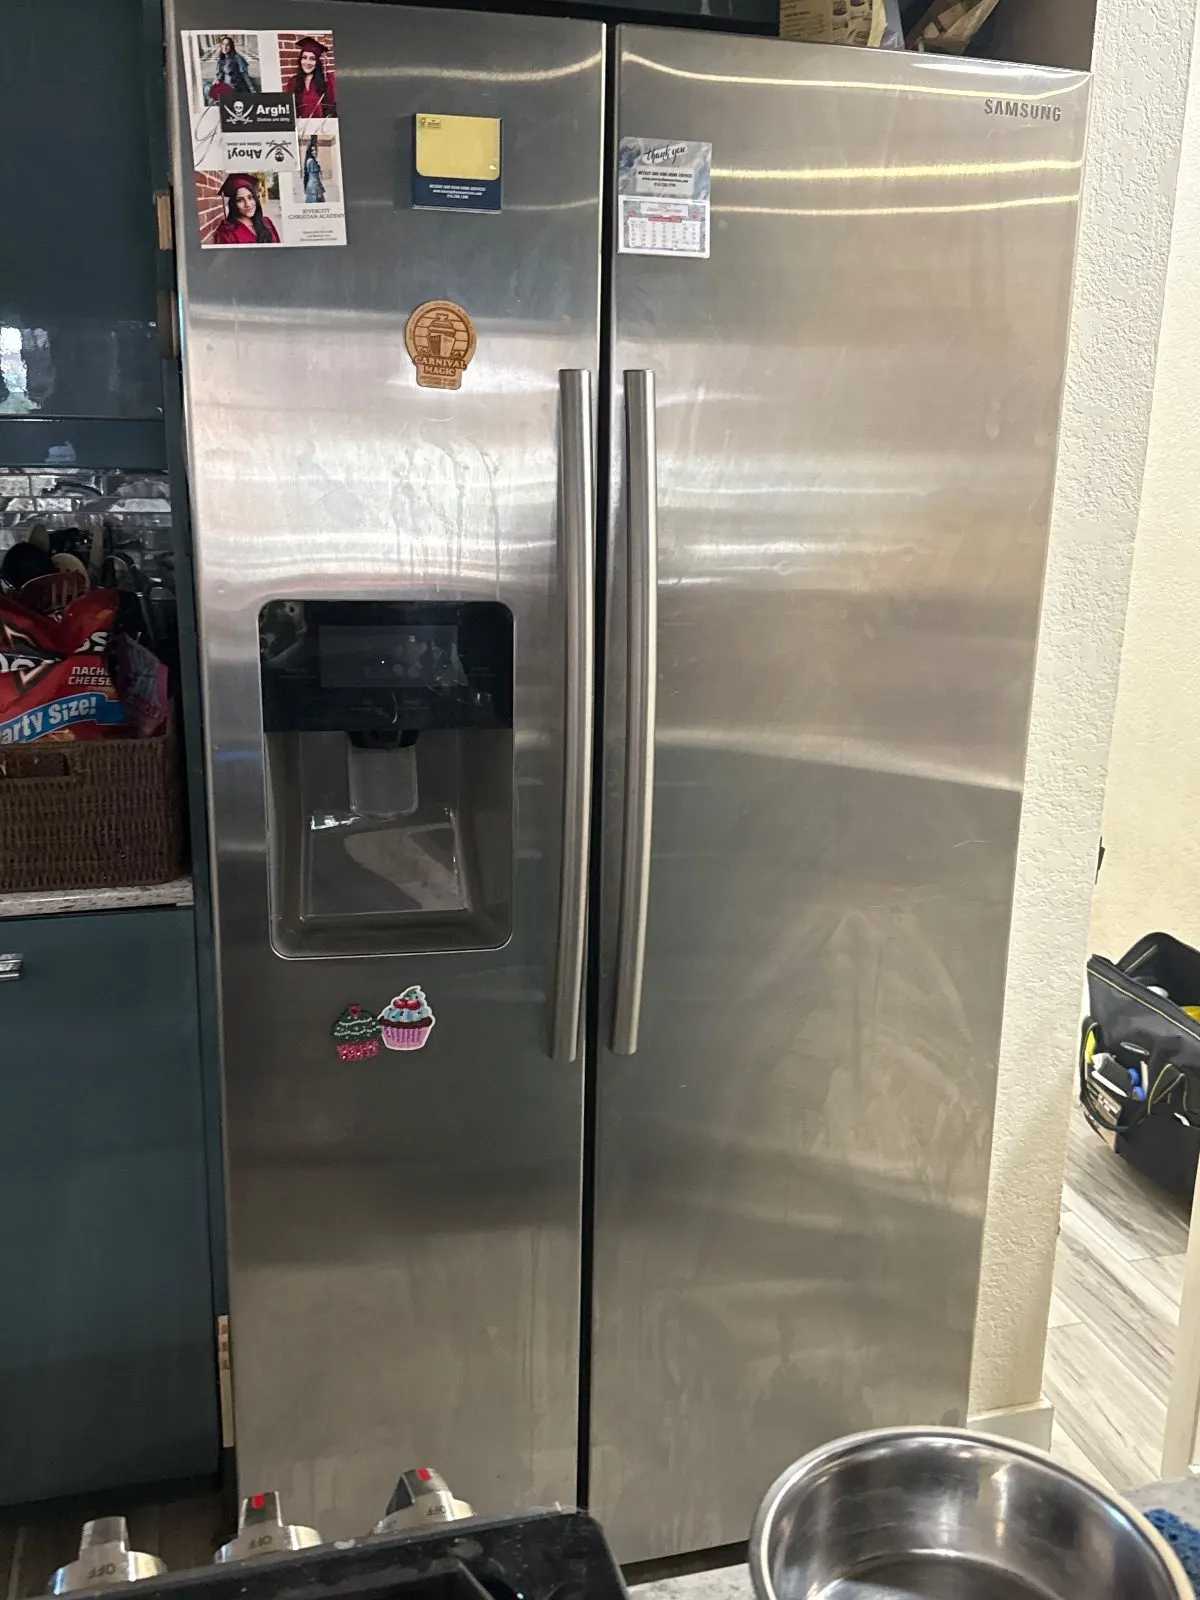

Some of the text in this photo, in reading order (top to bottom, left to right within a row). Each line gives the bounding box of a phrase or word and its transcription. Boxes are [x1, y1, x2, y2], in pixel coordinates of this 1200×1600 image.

[256, 104, 290, 117] Argh!
[984, 98, 1061, 122] SAMSUNG
[227, 147, 262, 160] Ahoy!
[414, 356, 467, 369] CARNIVAL
[424, 365, 456, 375] MAGIC
[48, 697, 97, 724] Size!
